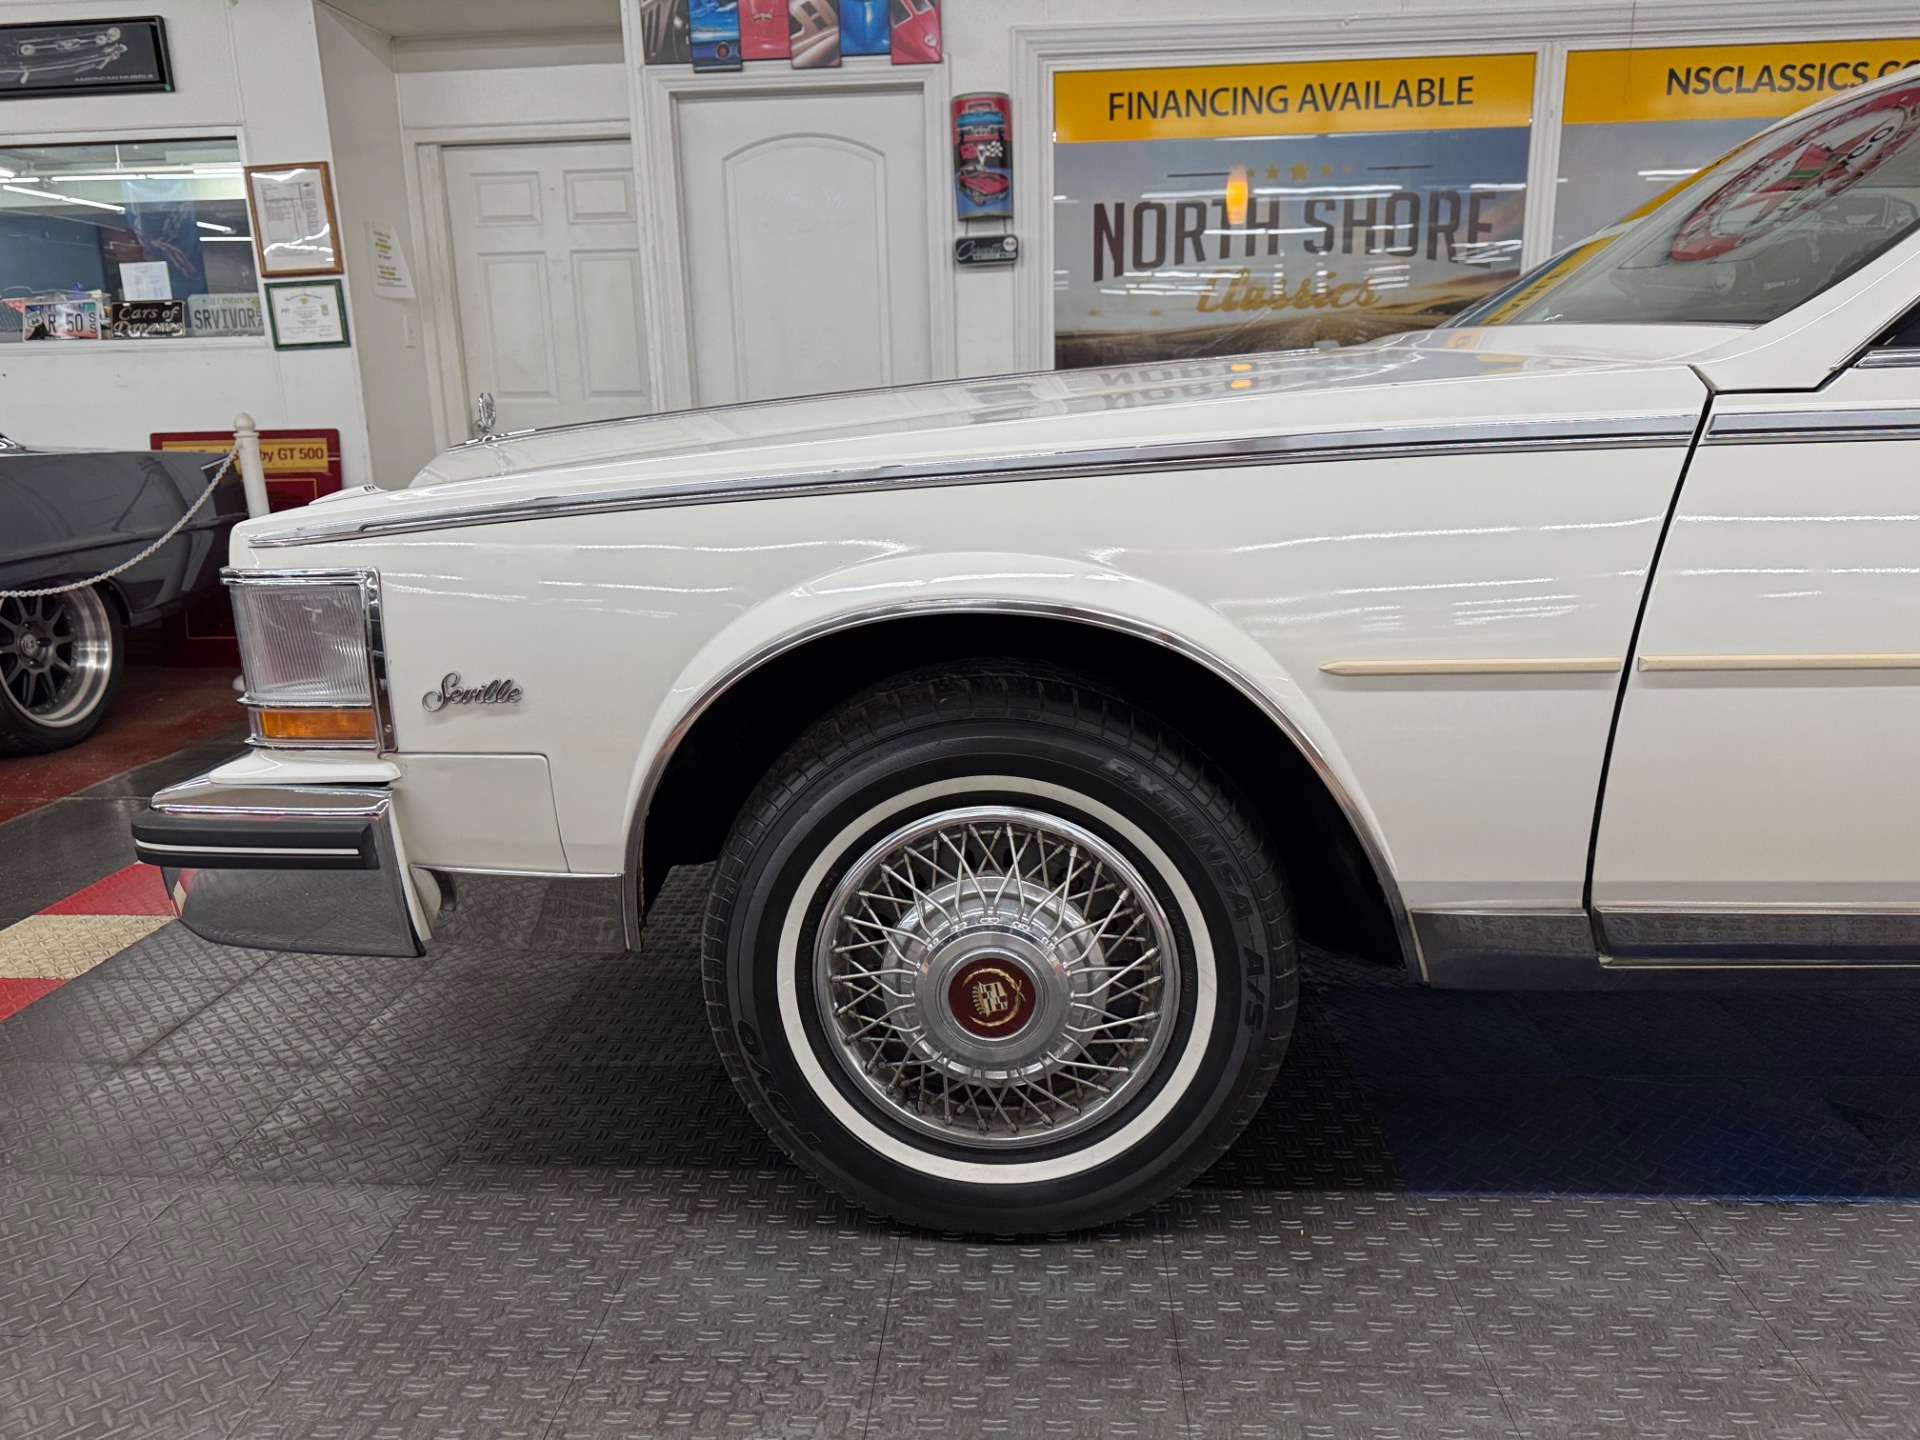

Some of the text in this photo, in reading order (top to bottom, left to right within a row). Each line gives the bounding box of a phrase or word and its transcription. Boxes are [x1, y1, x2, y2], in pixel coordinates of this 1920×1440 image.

[1108, 75, 1475, 121] FINANCING AVAILABLE
[1093, 189, 1497, 283] NORTH SHORE
[1196, 267, 1383, 314] Classics
[118, 306, 181, 321] Cars of
[193, 308, 256, 330] SRVIVOR
[278, 447, 297, 460] GT
[299, 447, 324, 460] 500
[422, 671, 522, 712] Seville
